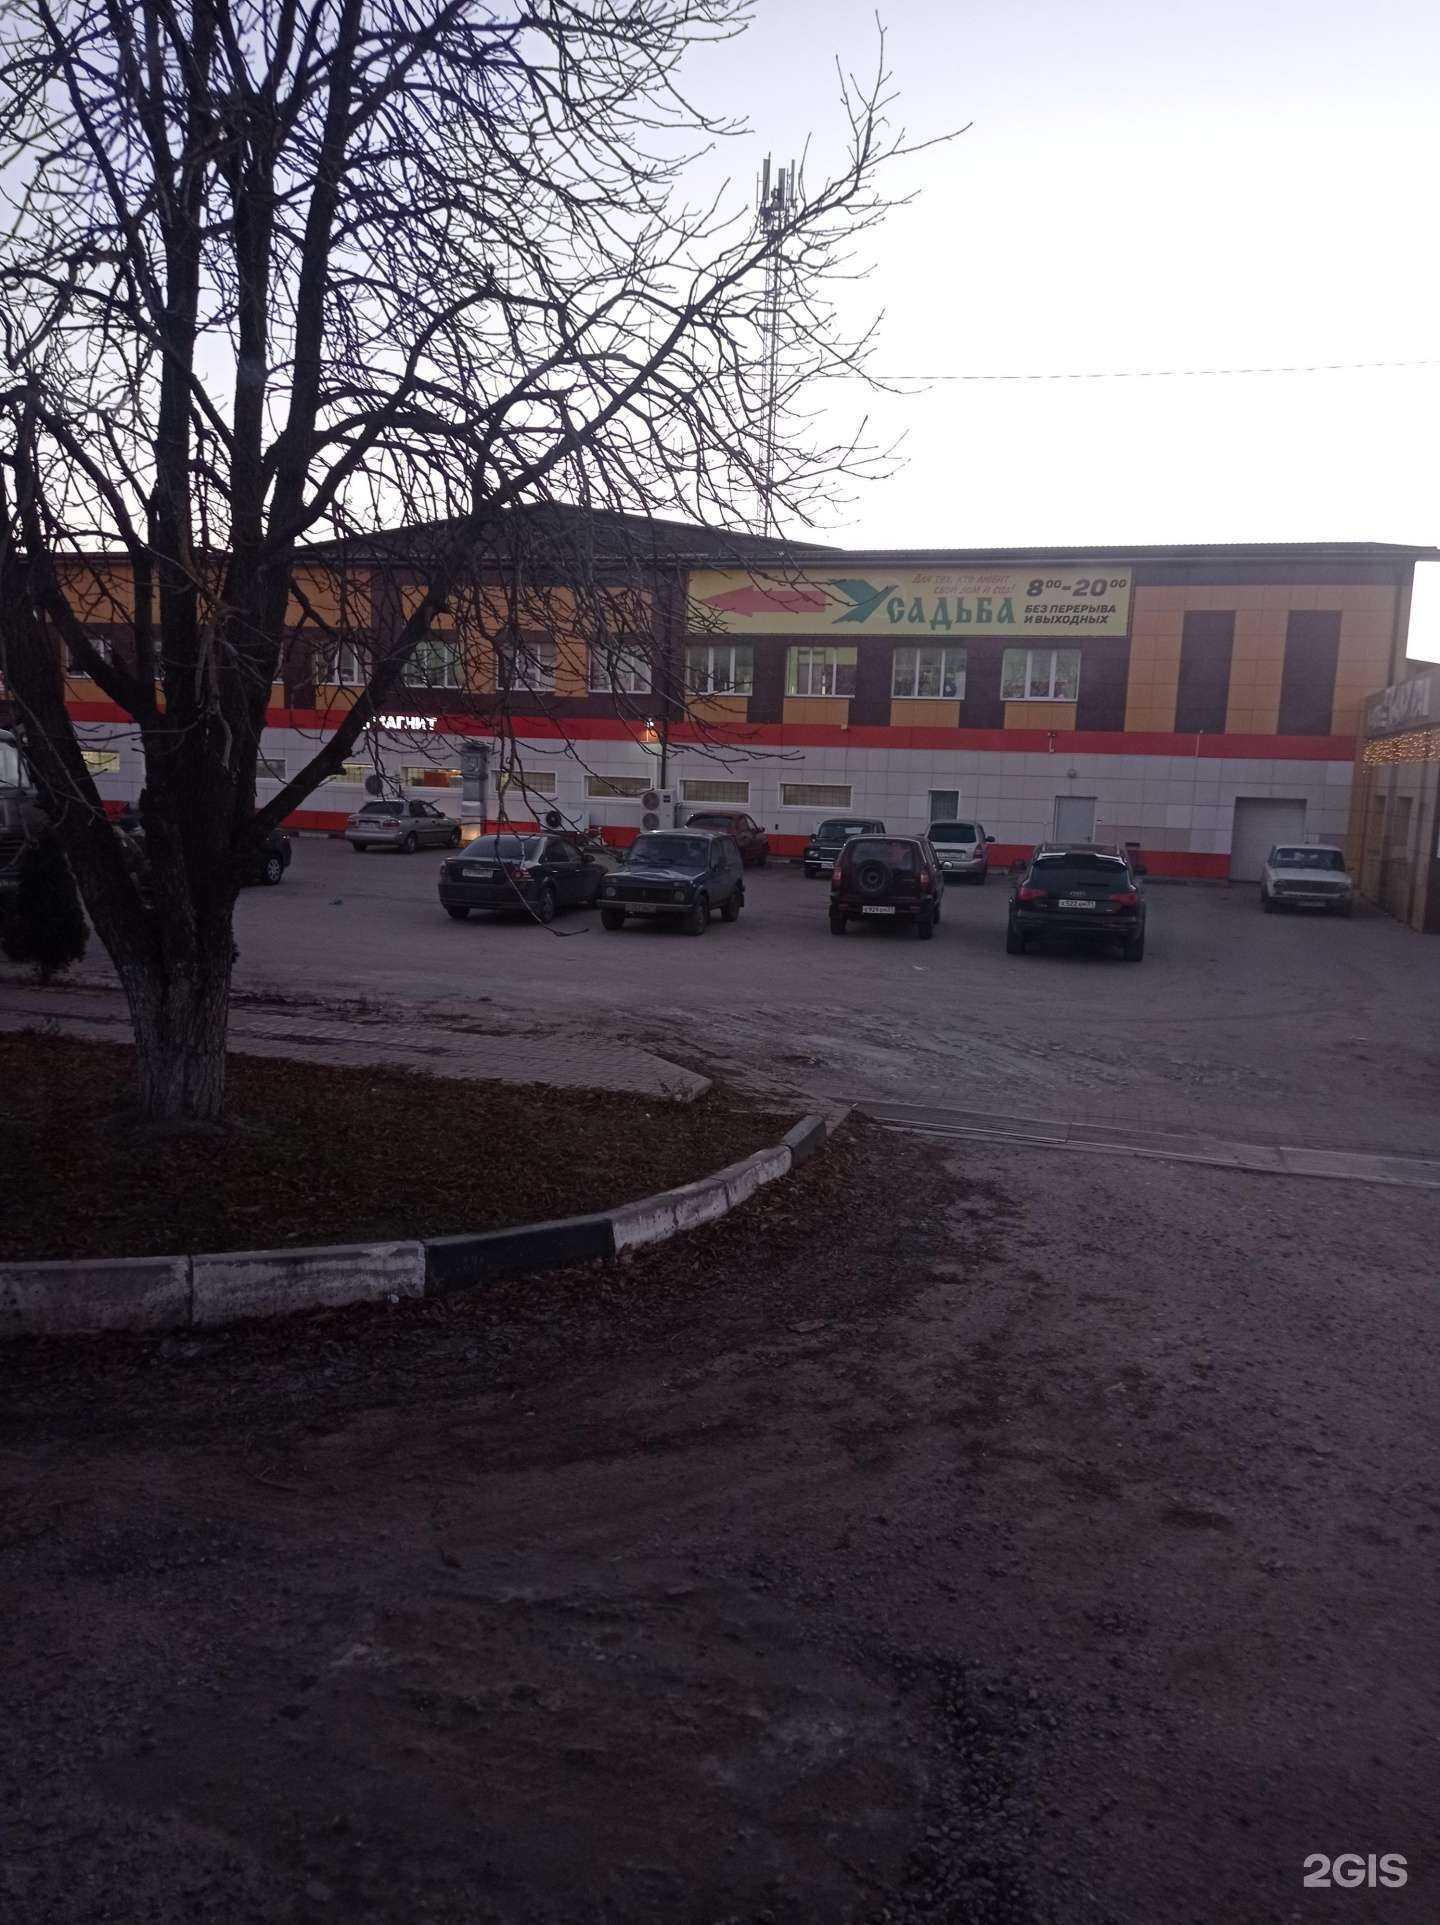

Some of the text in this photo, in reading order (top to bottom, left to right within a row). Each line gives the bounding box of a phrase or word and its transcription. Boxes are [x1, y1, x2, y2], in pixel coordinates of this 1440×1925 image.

[1024, 604, 1117, 614] БЕЗ ПЕРЕРЫВА
[1024, 615, 1110, 626] И ВЫХОДНЫХ
